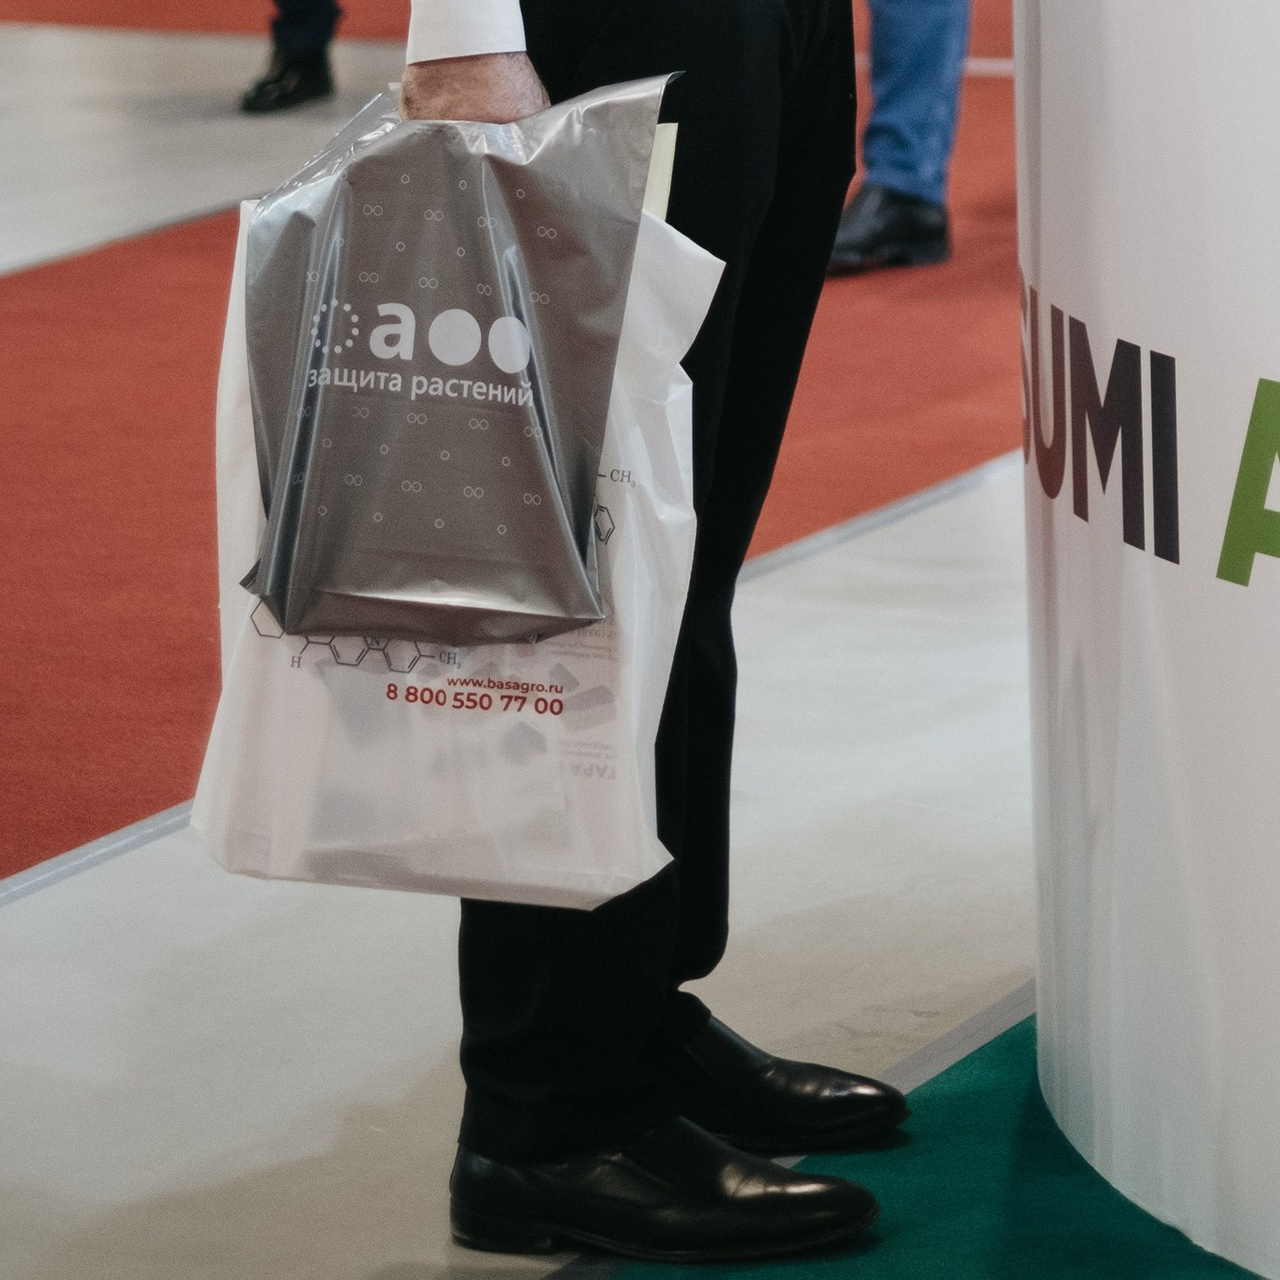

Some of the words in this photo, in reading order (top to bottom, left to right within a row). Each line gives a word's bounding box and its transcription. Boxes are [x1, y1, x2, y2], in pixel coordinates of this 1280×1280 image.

[308, 366, 402, 393] защита
[410, 375, 534, 408] растений
[386, 682, 398, 701] 8
[404, 685, 447, 707] 800
[452, 691, 493, 712] 550
[500, 694, 528, 713] 77
[534, 696, 564, 716] 00
[447, 676, 564, 695] www.basagro.ru
